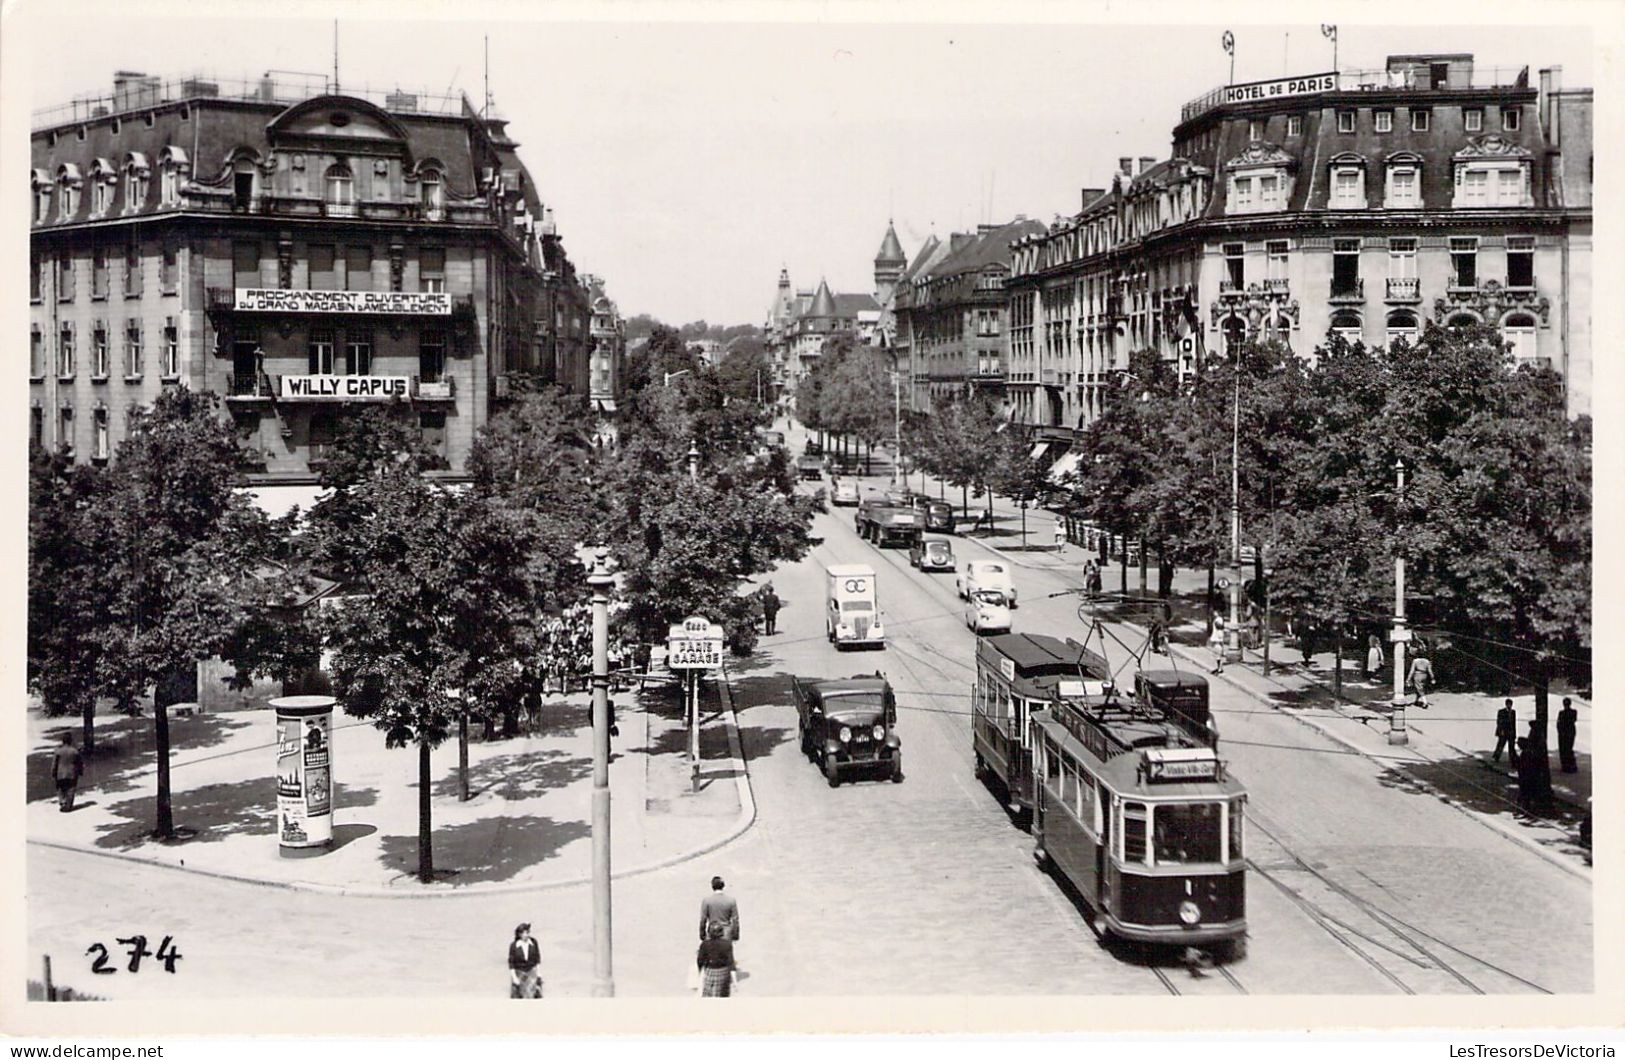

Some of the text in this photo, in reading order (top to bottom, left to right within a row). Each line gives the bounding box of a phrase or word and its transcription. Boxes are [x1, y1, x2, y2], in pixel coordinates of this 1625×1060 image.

[1227, 77, 1334, 101] HOTEL DE PARIS
[247, 290, 445, 303] PROCHAINEMENT OUVERTURE
[240, 301, 254, 309] DU
[257, 300, 299, 310] GRAND
[305, 301, 355, 311] MAGASIN
[680, 641, 713, 653] PARIS
[673, 653, 719, 664] GARAGE
[85, 935, 183, 974] 274
